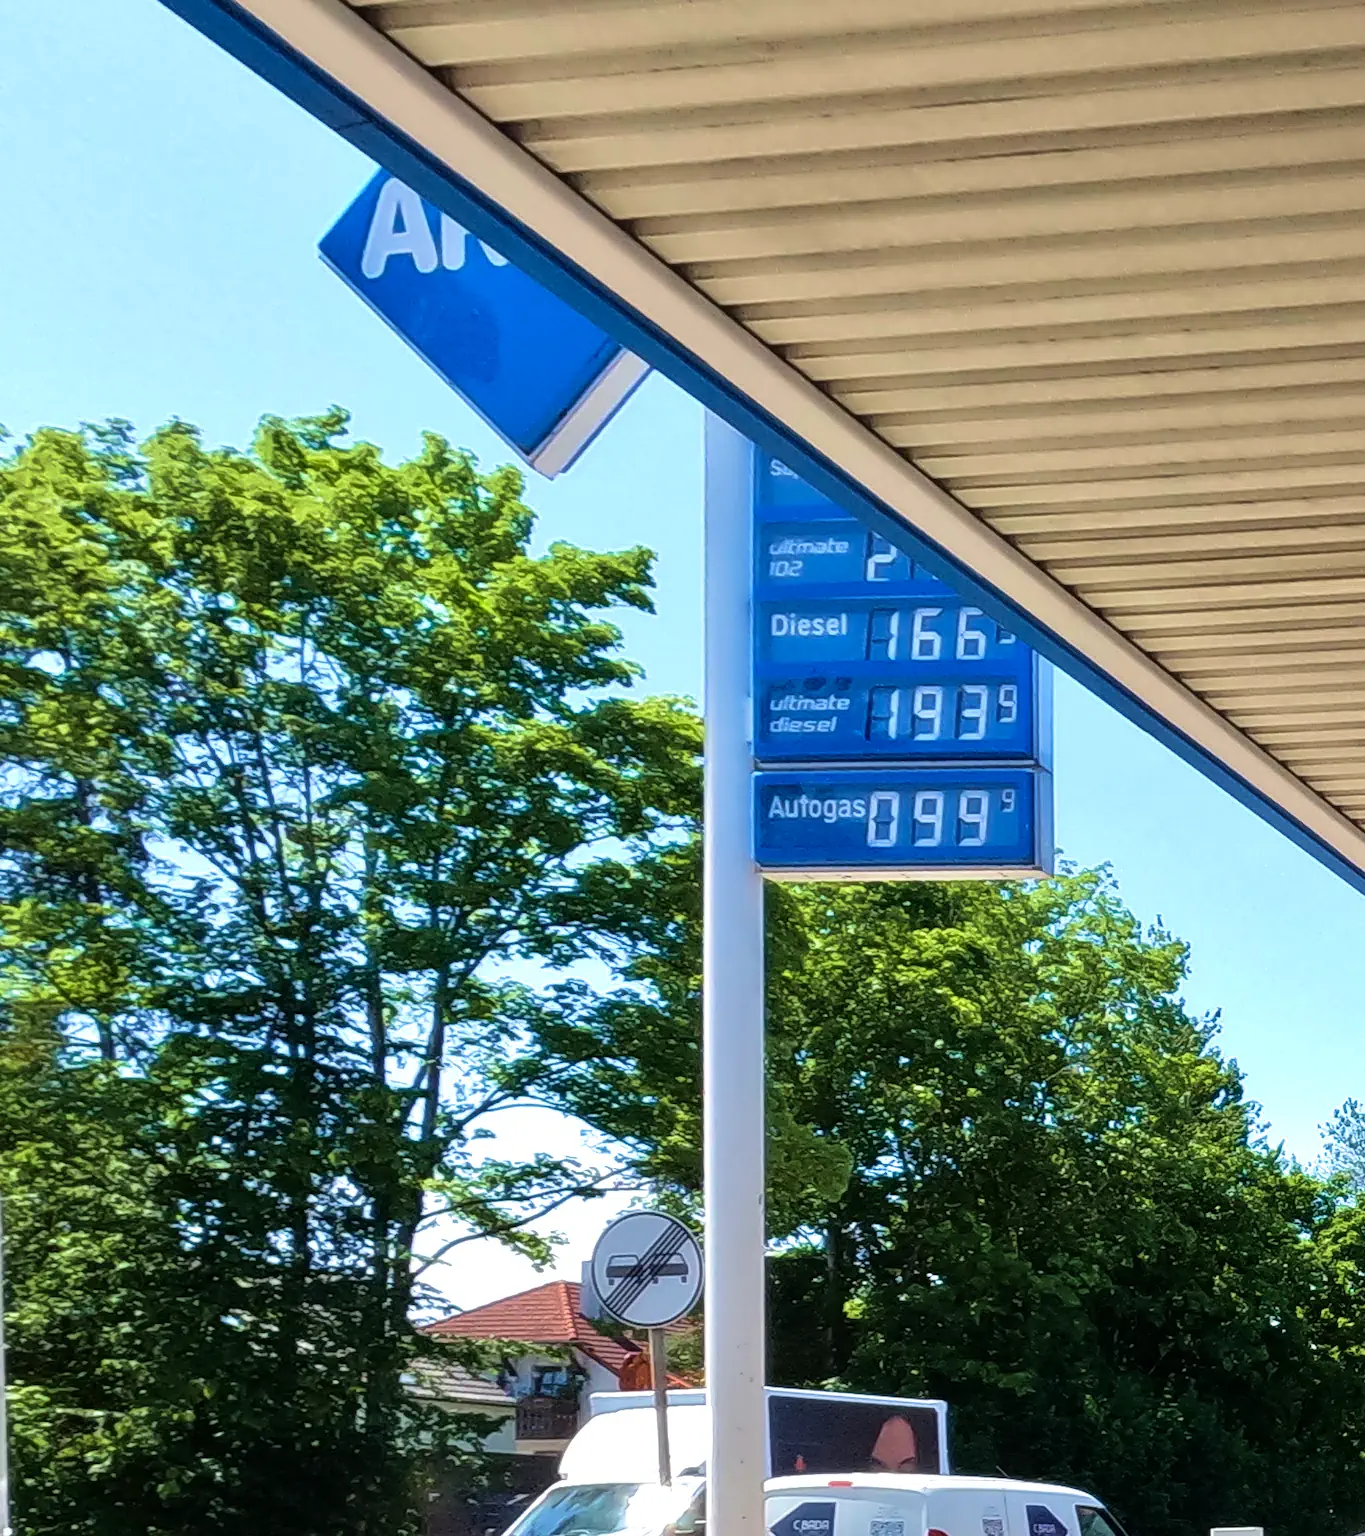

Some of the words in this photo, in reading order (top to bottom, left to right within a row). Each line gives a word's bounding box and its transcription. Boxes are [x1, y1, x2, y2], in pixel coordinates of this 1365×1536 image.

[769, 537, 849, 554] ultimate
[769, 560, 803, 577] 102
[771, 613, 847, 636] Diesel
[769, 695, 850, 711] ultimate
[769, 716, 837, 733] diesel
[768, 795, 866, 823] Autogas
